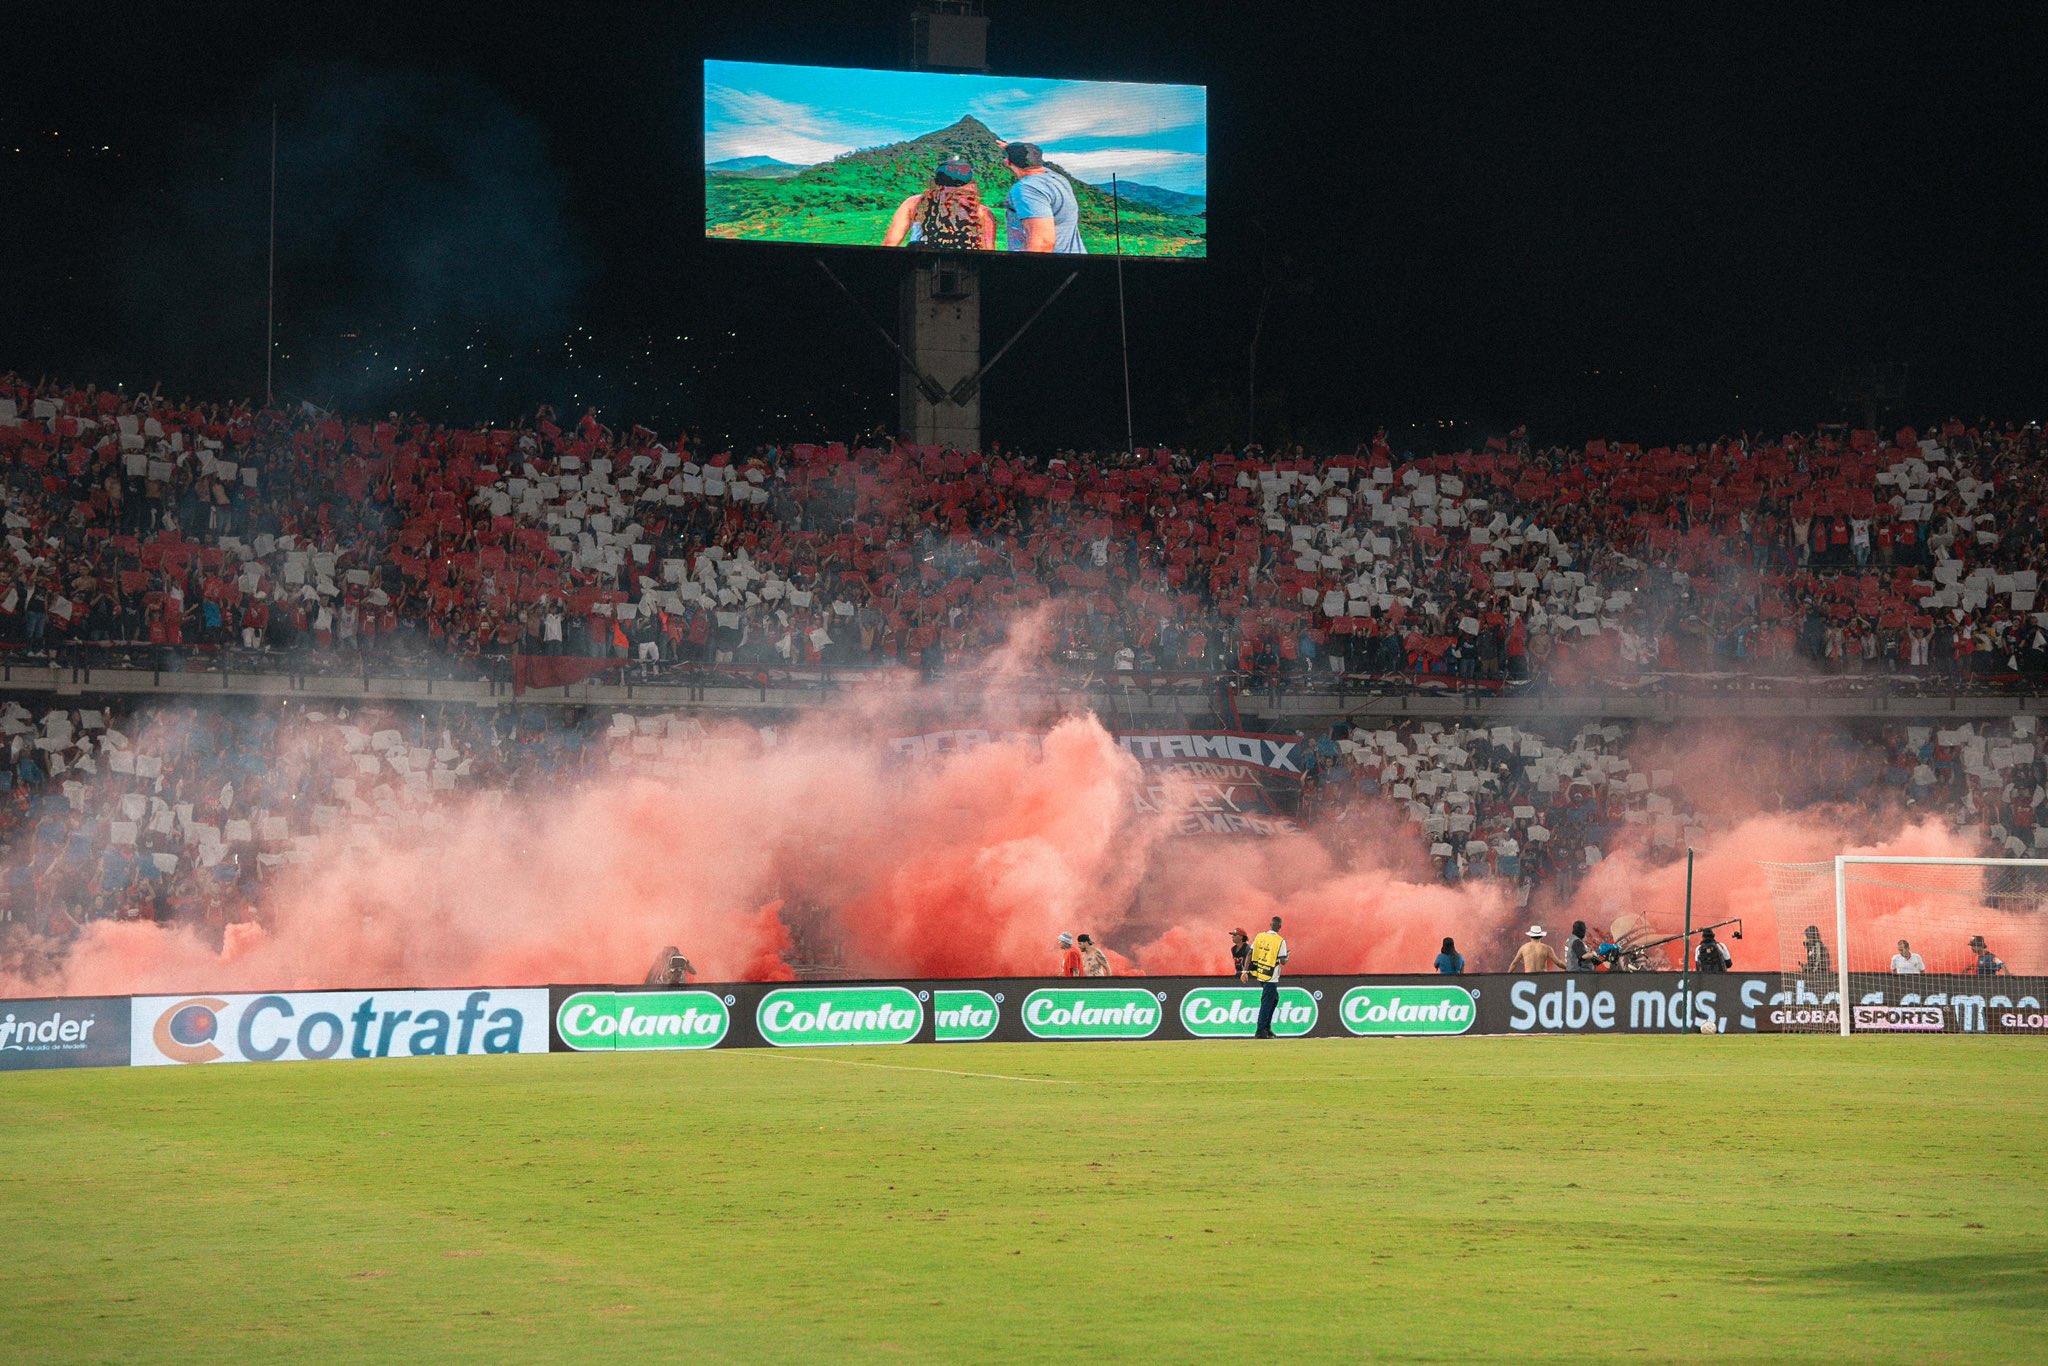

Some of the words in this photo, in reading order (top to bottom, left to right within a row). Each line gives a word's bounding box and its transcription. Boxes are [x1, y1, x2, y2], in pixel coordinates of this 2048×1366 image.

[563, 1002, 723, 1037] Colanta
[764, 998, 916, 1032] Colanta
[1028, 998, 1156, 1026] Colanta
[1345, 995, 1470, 1023] Colanta
[1510, 979, 1615, 1030] Sabe
[1770, 1010, 1840, 1024] GLOBA
[1859, 1010, 1940, 1025] SPORTS
[237, 992, 524, 1062] Cotrafa
